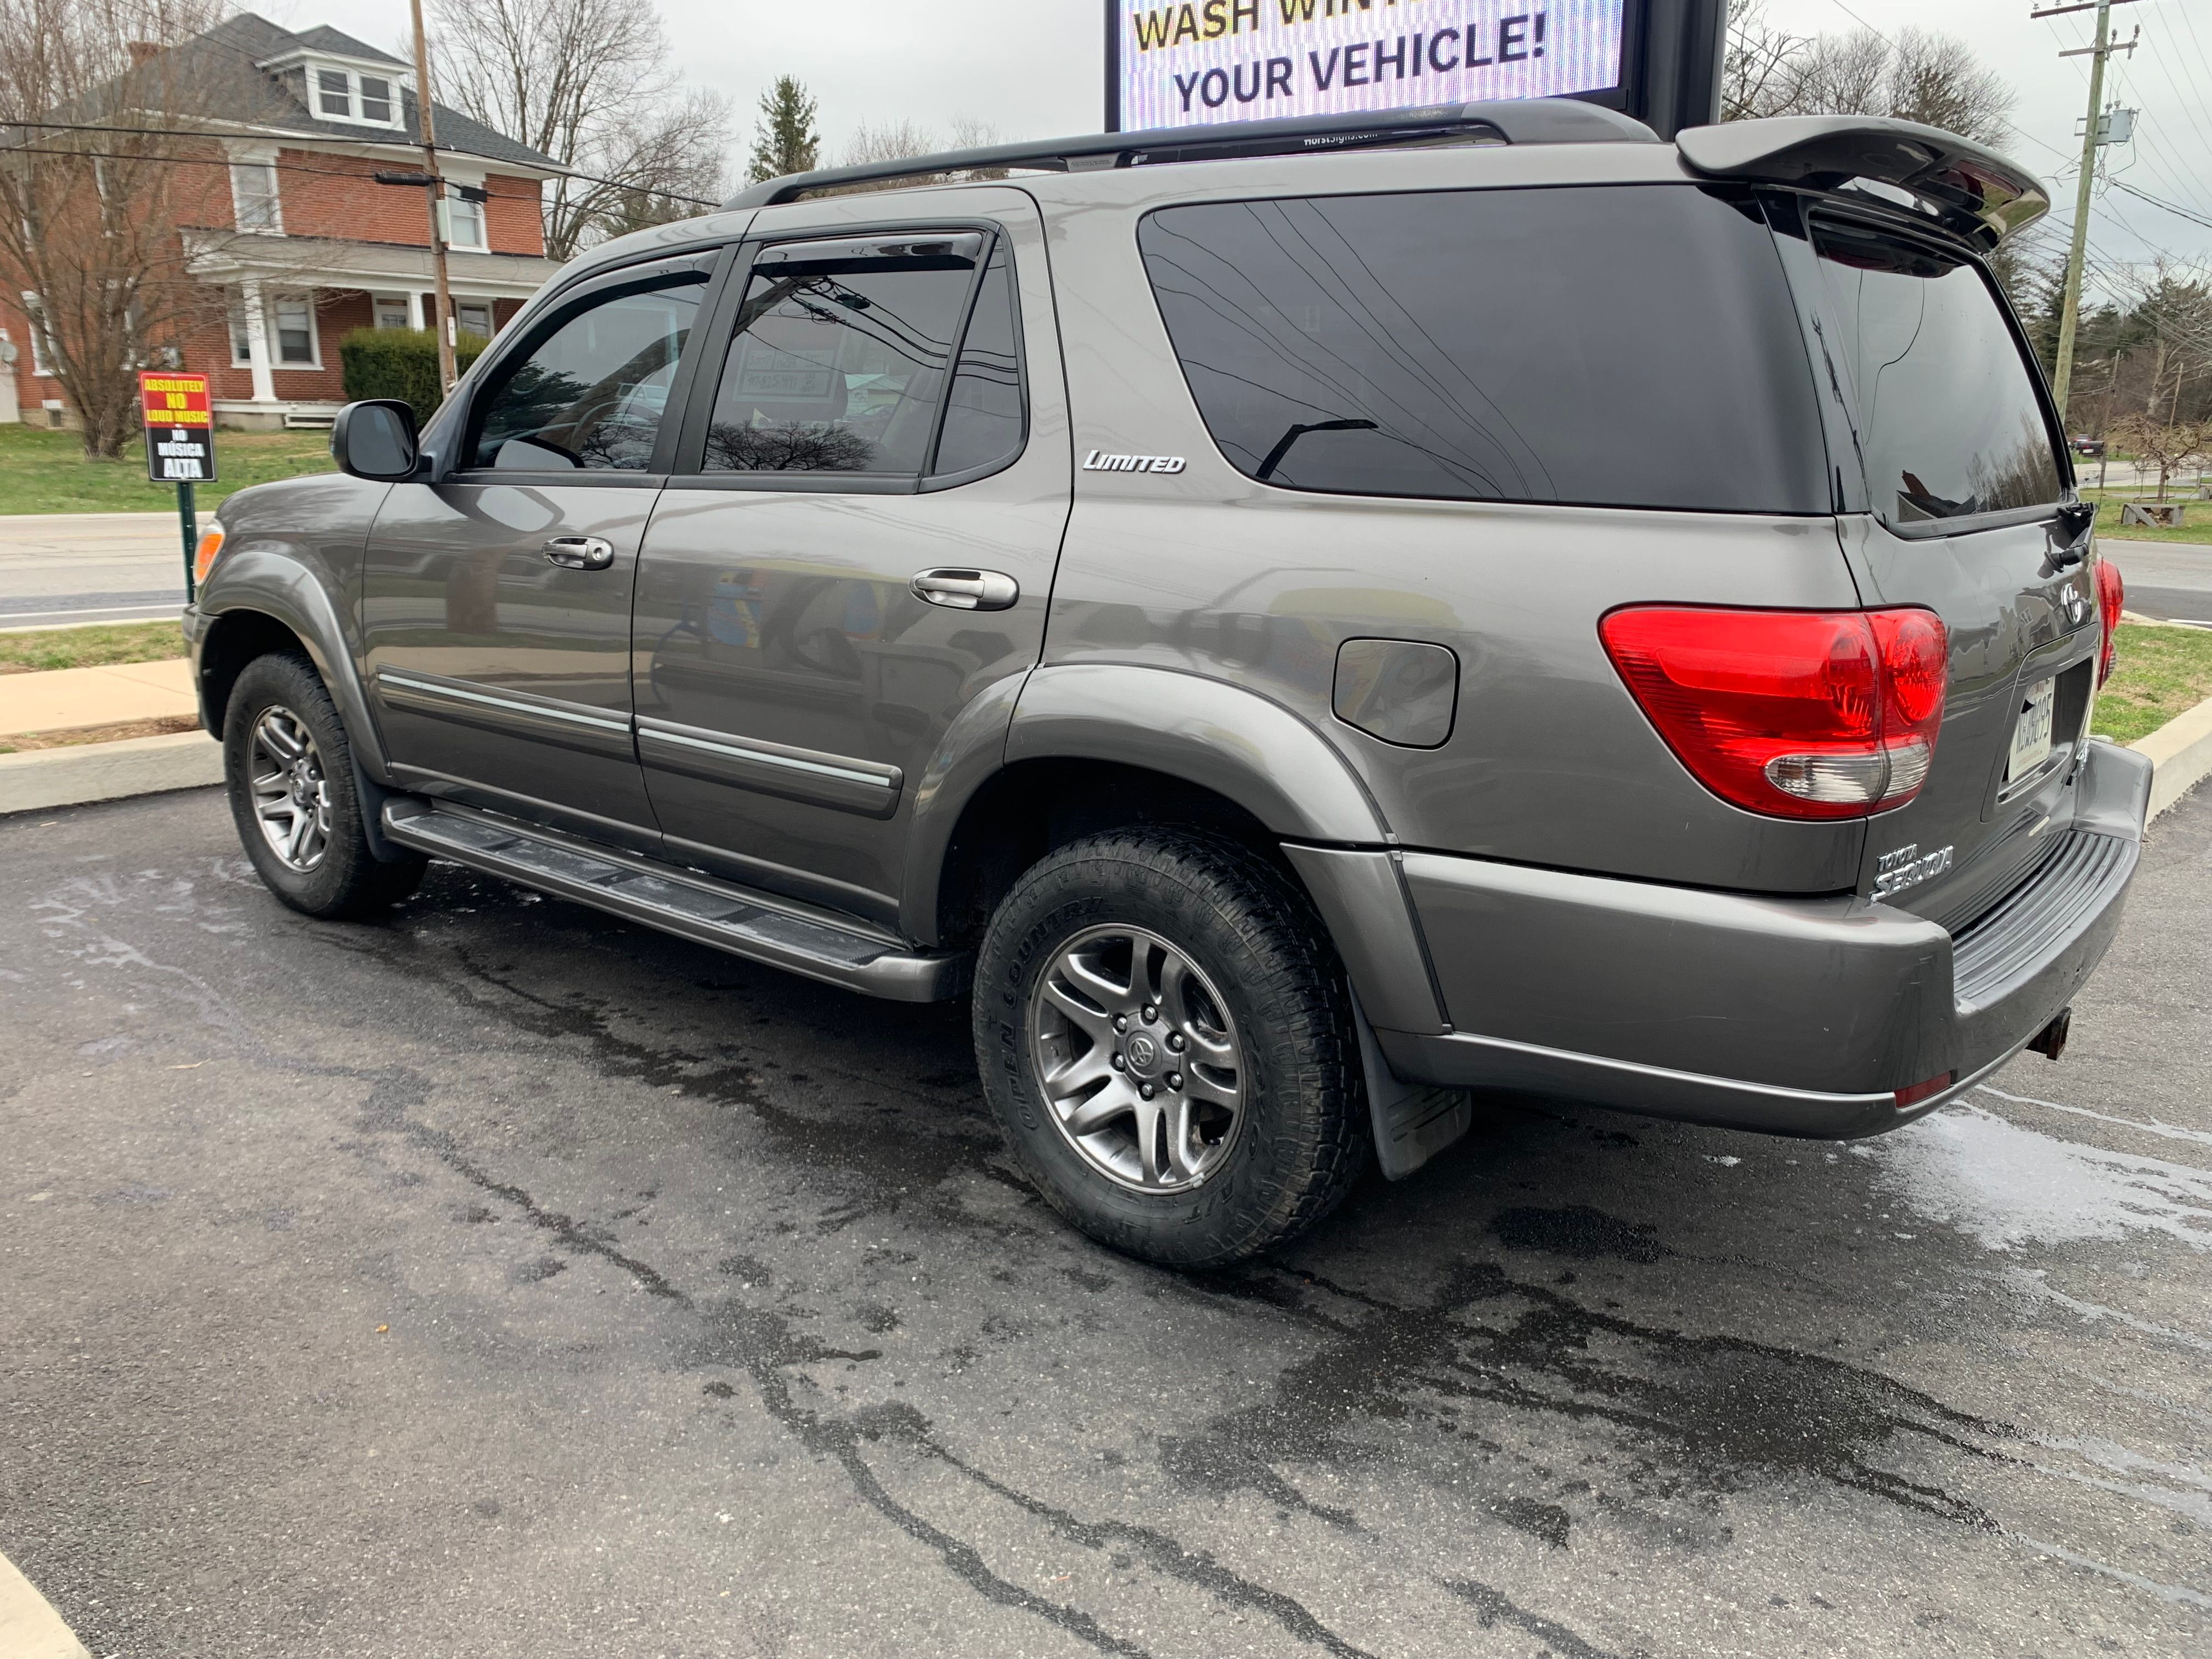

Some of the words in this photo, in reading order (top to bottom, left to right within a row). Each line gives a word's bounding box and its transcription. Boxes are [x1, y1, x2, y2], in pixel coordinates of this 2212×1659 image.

[1133, 0, 1259, 51] WASH
[1173, 56, 1293, 112] YOUR
[1307, 12, 1547, 92] VEHICLE!
[145, 380, 204, 392] ABSOLUTELY
[166, 393, 188, 409] NO
[146, 409, 173, 422] LOUD
[174, 410, 210, 422] MUSIC
[172, 430, 188, 441] NO
[163, 458, 204, 478] ALTA
[1877, 843, 1917, 872] TOYOTA
[1870, 845, 1954, 901] SEQUOIA
